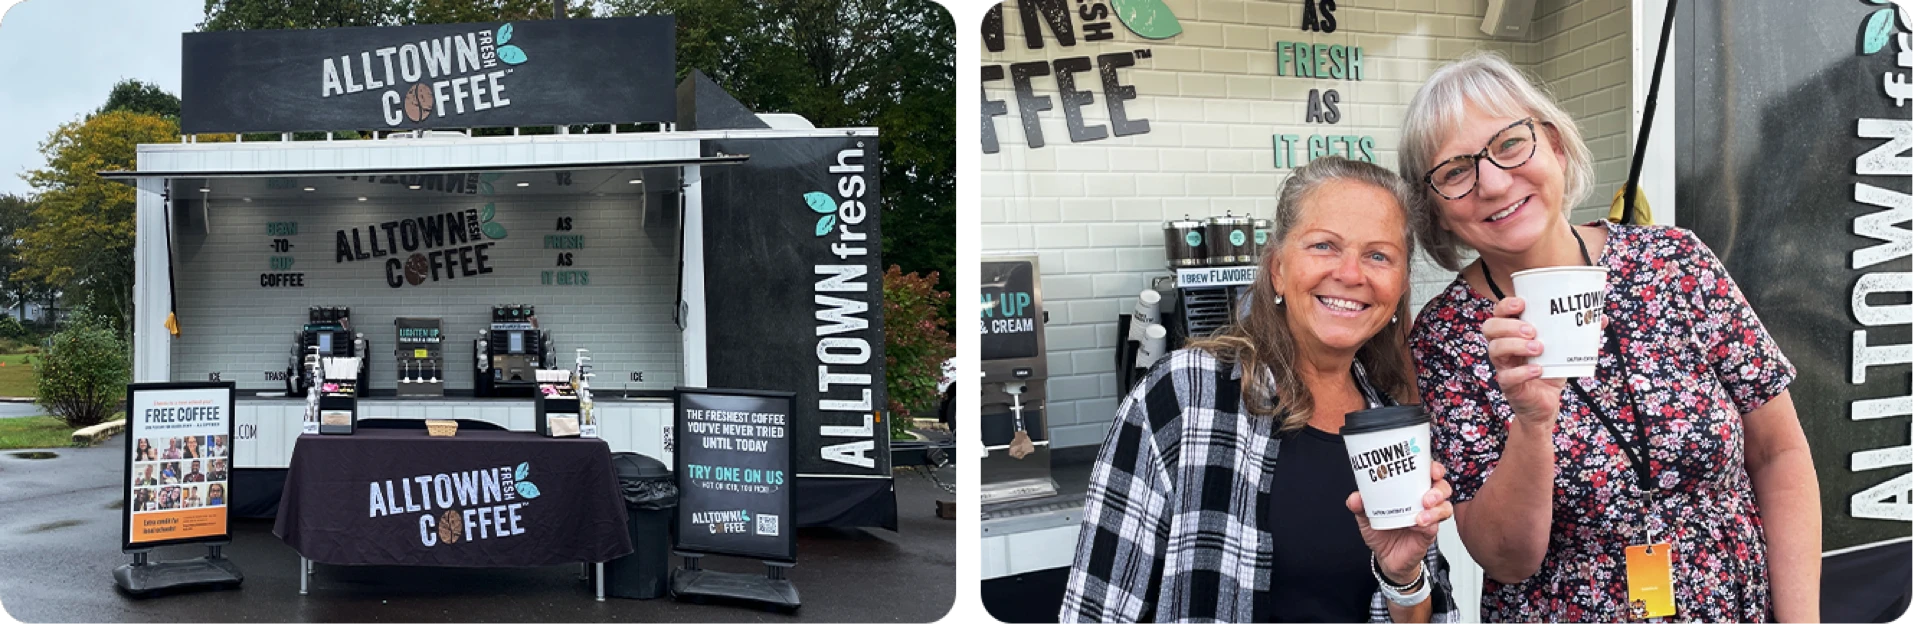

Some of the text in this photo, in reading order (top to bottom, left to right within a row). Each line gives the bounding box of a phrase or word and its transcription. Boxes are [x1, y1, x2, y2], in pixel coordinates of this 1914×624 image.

[1302, 0, 1337, 33] AS
[478, 29, 498, 68] FRESH
[322, 33, 481, 97] ALLTOWN
[1277, 41, 1365, 81] FRESH
[382, 69, 511, 126] COFFEE
[1306, 89, 1341, 124] AS
[1273, 134, 1299, 168] IT
[266, 222, 298, 236] BEAN
[465, 208, 481, 241] FRESH
[556, 216, 572, 232] AS
[336, 211, 468, 263] ALLTOWN
[544, 234, 585, 249] FRESH
[270, 256, 294, 270] CUP
[385, 243, 494, 288] COFFEE
[556, 252, 573, 267] AS
[260, 273, 304, 288] COFFEE
[541, 270, 590, 286] IT GETS
[1187, 273, 1208, 283] BREW
[1000, 292, 1031, 317] UP
[992, 318, 1034, 334] CREAM
[814, 264, 875, 468] ALLTOWN
[209, 372, 220, 382] ICE
[630, 372, 643, 382] ICE
[145, 406, 220, 423] FREE COFFEE
[687, 409, 785, 425] THE FRESHEST COFFEE
[688, 422, 784, 438] YOU'VE NEVER TRIED
[702, 436, 768, 452] UNTIL TODAY
[688, 464, 784, 484] TRY ONE ON US
[1369, 456, 1416, 482] COFFEE
[369, 467, 502, 518] ALLTOWN
[500, 466, 515, 501] FRESH
[419, 502, 525, 547] COFFEE
[692, 511, 740, 524] ALLTOWN
[709, 522, 746, 534] COFFEE
